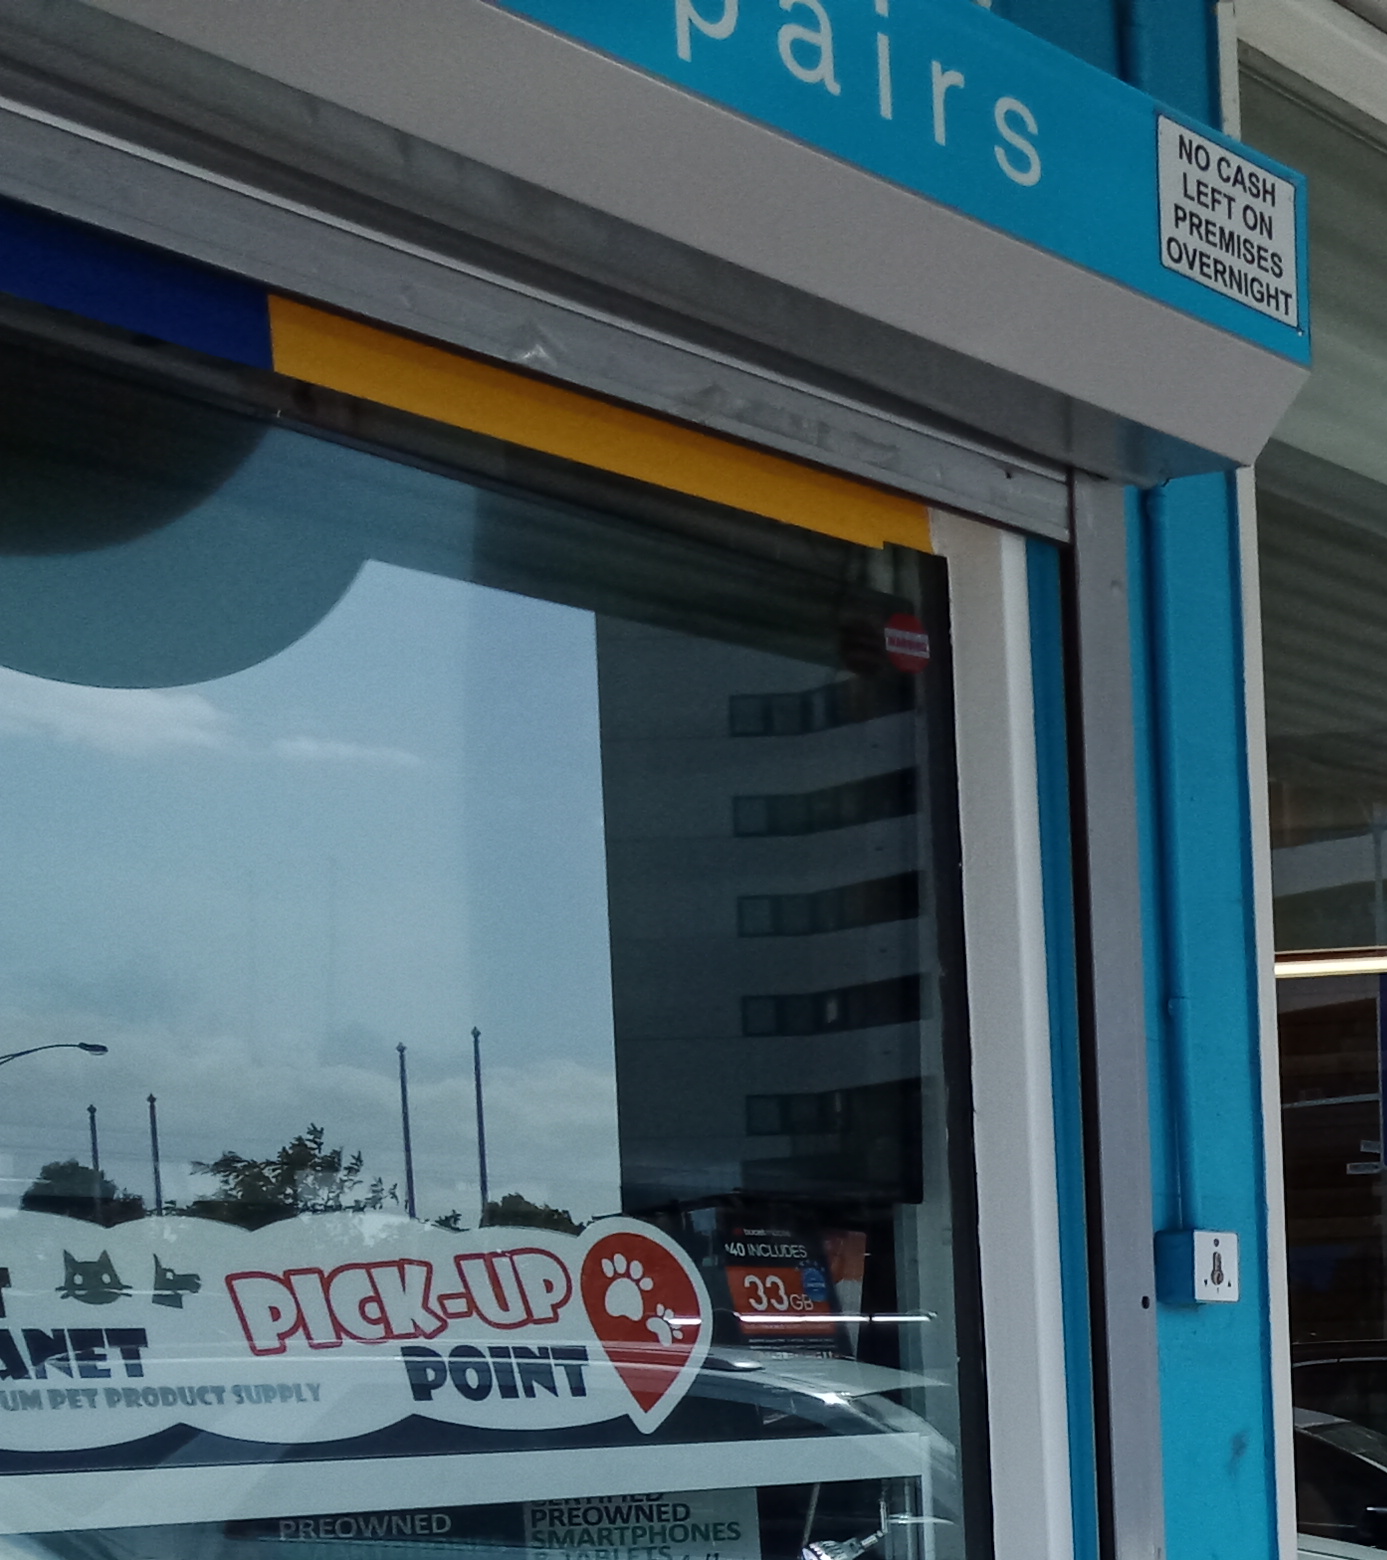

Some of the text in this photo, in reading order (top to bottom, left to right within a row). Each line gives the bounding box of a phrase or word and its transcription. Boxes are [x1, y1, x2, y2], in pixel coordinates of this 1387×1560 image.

[1178, 134, 1276, 207] NO CASH
[1182, 172, 1273, 241] LEFT ON
[1174, 203, 1284, 279] PREMISES
[1166, 236, 1292, 316] OVERNIGHT
[747, 1243, 808, 1259] INCLUDES
[225, 1246, 574, 1357] PICK-UP
[46, 1388, 99, 1411] PET
[103, 1384, 227, 1410] PRODUCT
[231, 1382, 322, 1405] SUPPLY
[401, 1345, 591, 1402] POINT
[278, 1512, 453, 1541] PREOWNED
[530, 1502, 691, 1529] PREOWNED
[531, 1521, 742, 1549] SMARTPHONES
